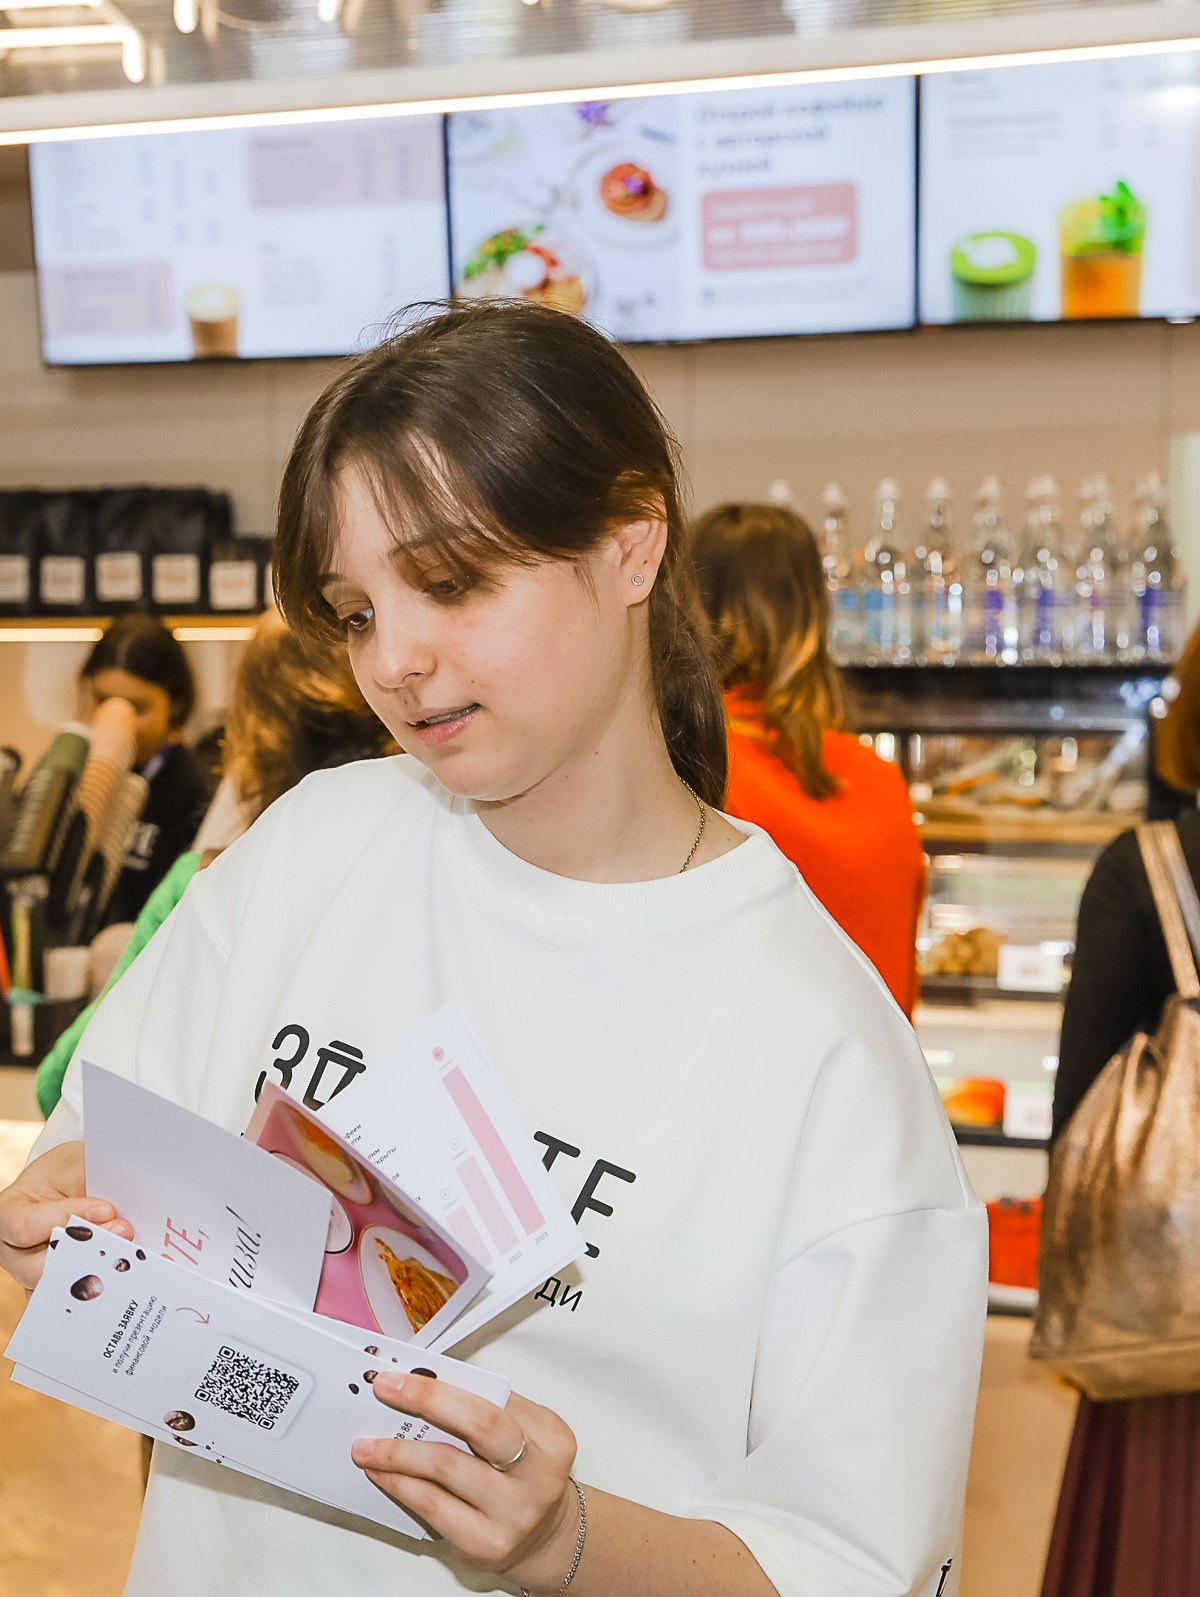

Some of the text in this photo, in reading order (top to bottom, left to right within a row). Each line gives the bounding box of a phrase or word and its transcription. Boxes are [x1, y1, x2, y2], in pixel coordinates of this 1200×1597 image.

[375, 1147, 397, 1164] крыты
[103, 1299, 138, 1359] ОСТАВЬ ЗАЯВКУ
[115, 1343, 132, 1368] получи
[128, 1296, 157, 1343] презентацию
[125, 1305, 168, 1376] финансовой модели
